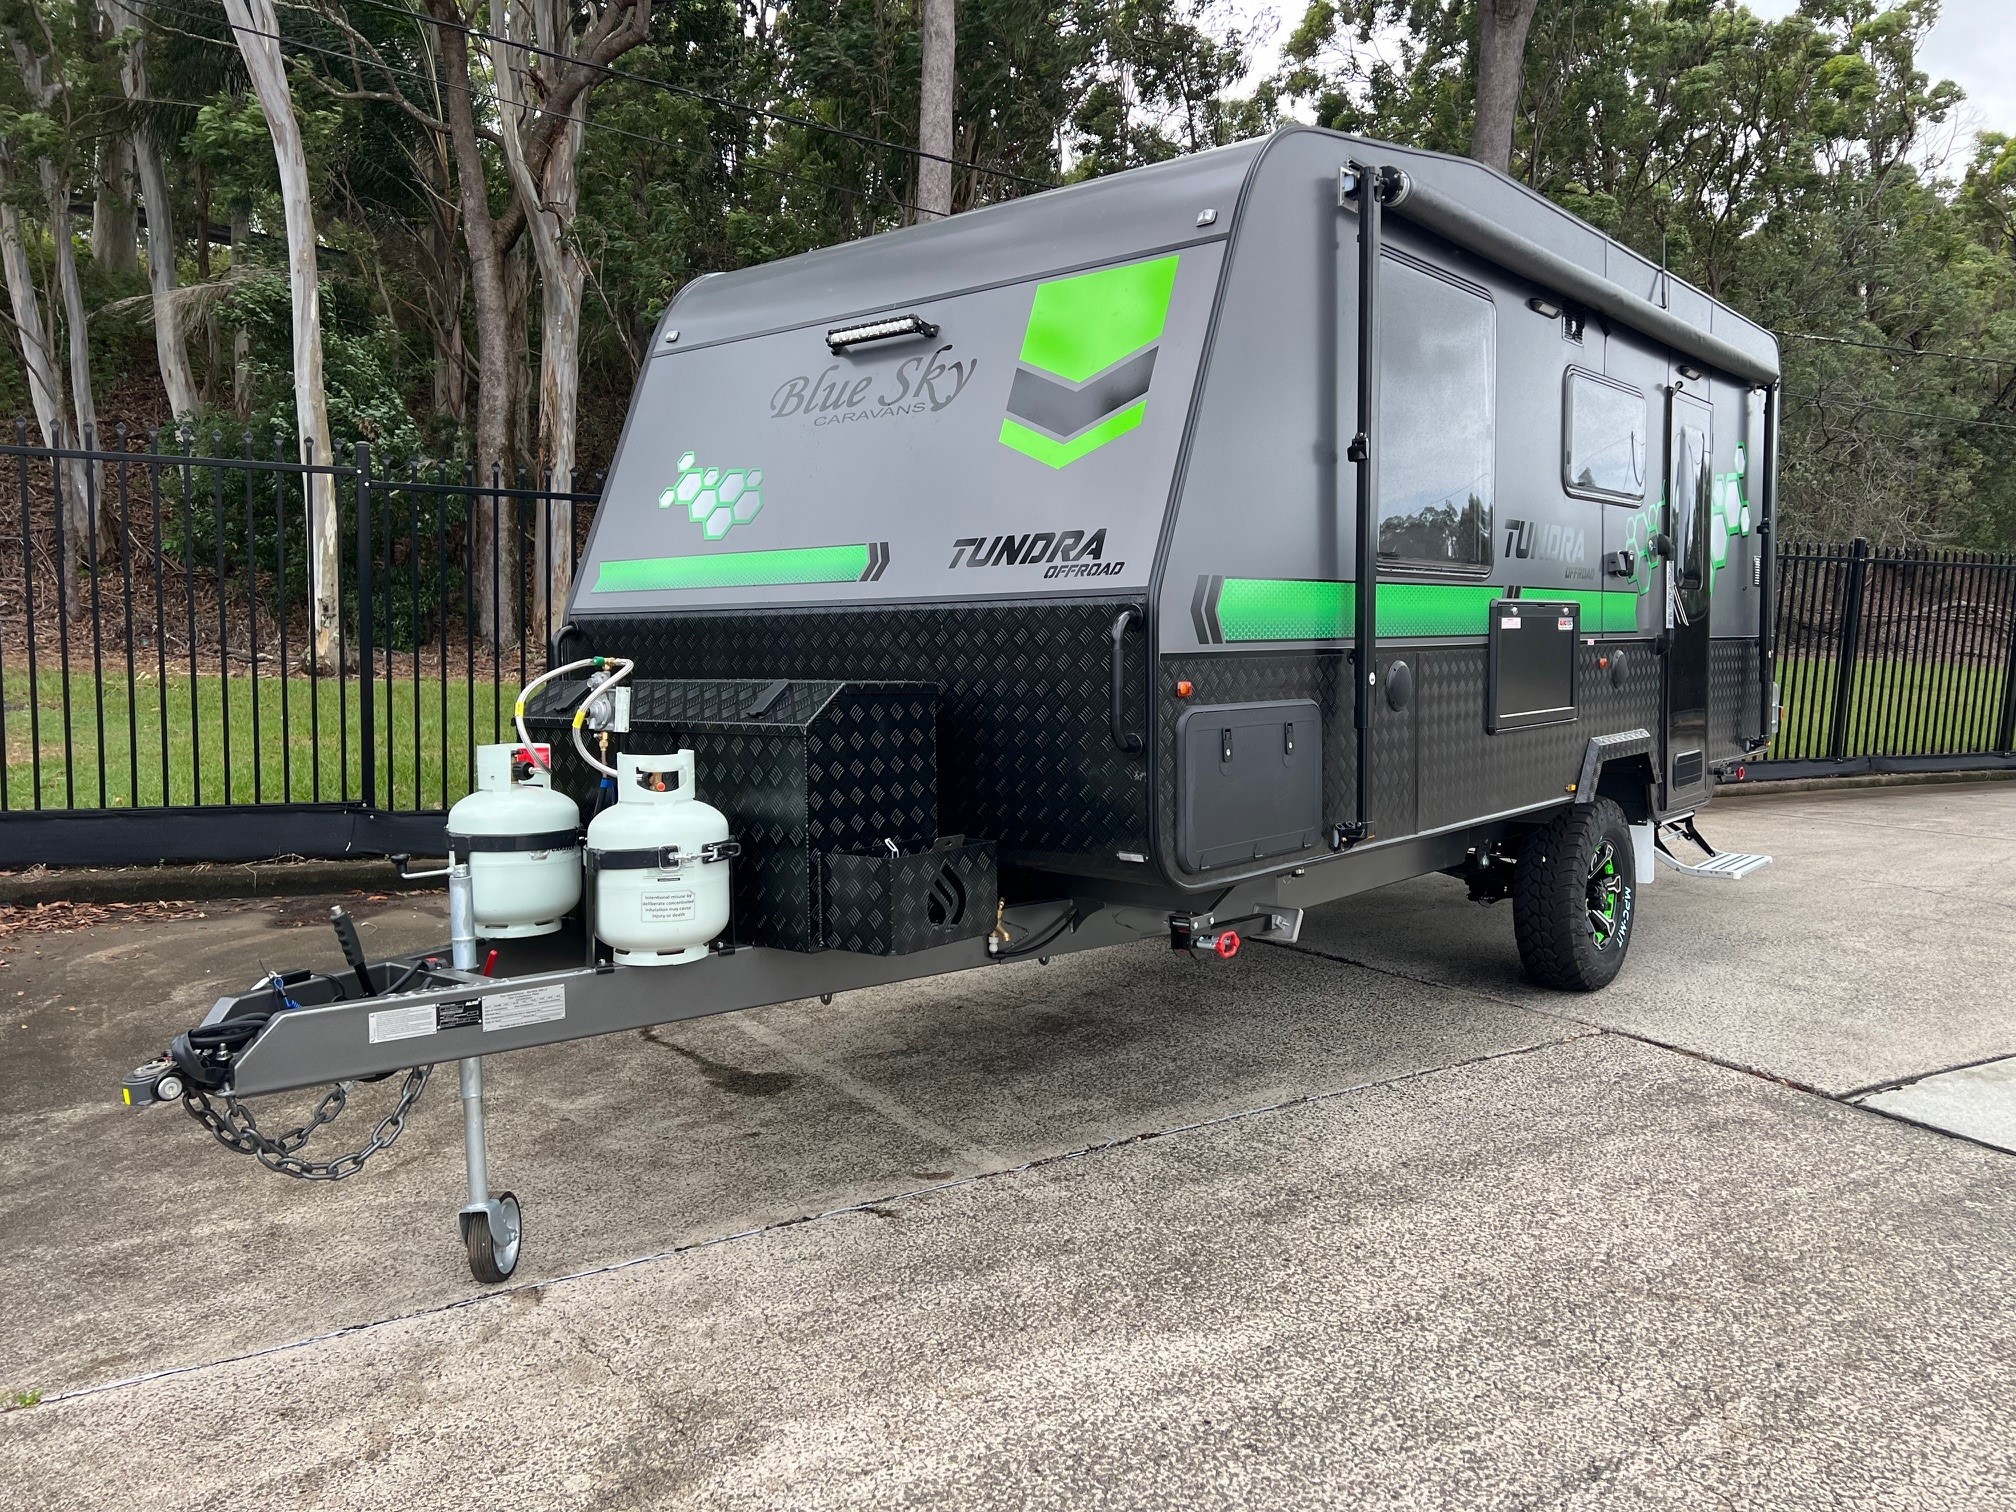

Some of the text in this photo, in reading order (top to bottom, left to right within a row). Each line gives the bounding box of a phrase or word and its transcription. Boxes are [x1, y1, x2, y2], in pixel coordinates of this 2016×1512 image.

[770, 344, 978, 419] Blue Sky
[814, 402, 926, 427] CARAVANS
[948, 528, 1107, 569] TUNDRA
[1504, 518, 1585, 563] TUNDRA
[1043, 561, 1126, 579] OFFROAD
[1564, 565, 1596, 580] OFFROAD
